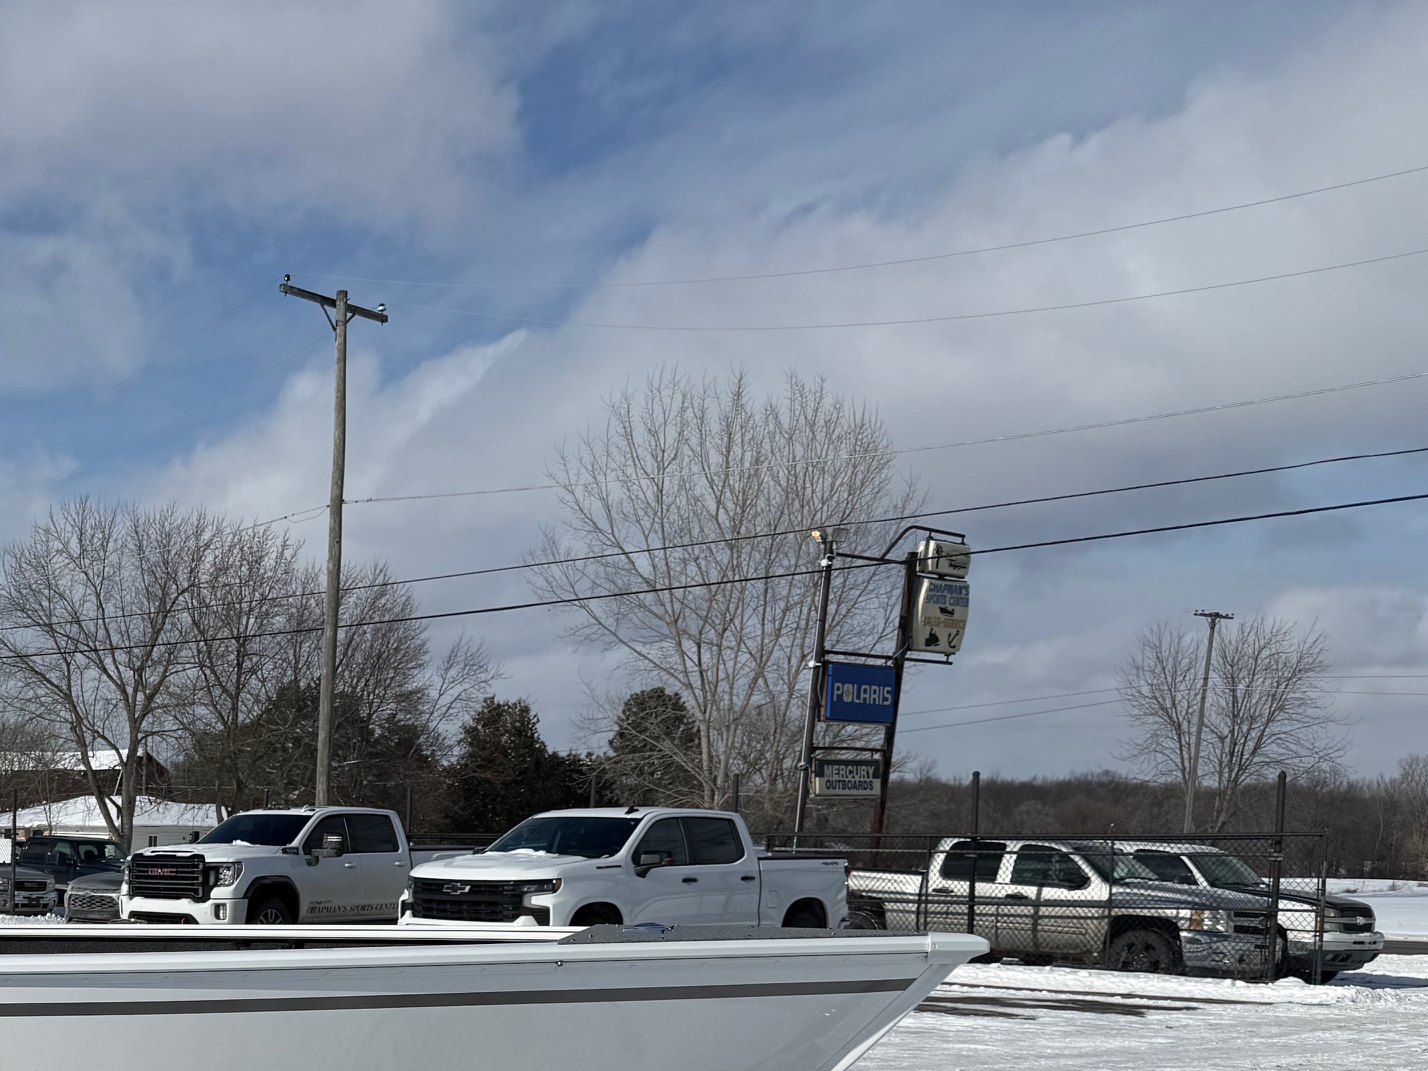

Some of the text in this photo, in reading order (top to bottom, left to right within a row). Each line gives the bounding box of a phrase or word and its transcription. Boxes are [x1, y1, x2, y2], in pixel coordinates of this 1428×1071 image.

[928, 582, 970, 597] CHAPMAN'S
[925, 593, 970, 608] SPORTS CENTER
[833, 682, 892, 706] POLARIS
[824, 764, 875, 779] MERCURY
[825, 780, 874, 791] OUTBOARDS
[148, 867, 177, 876] GMC
[306, 905, 347, 914] CHAPMAN'S
[348, 903, 374, 913] SPORTS
